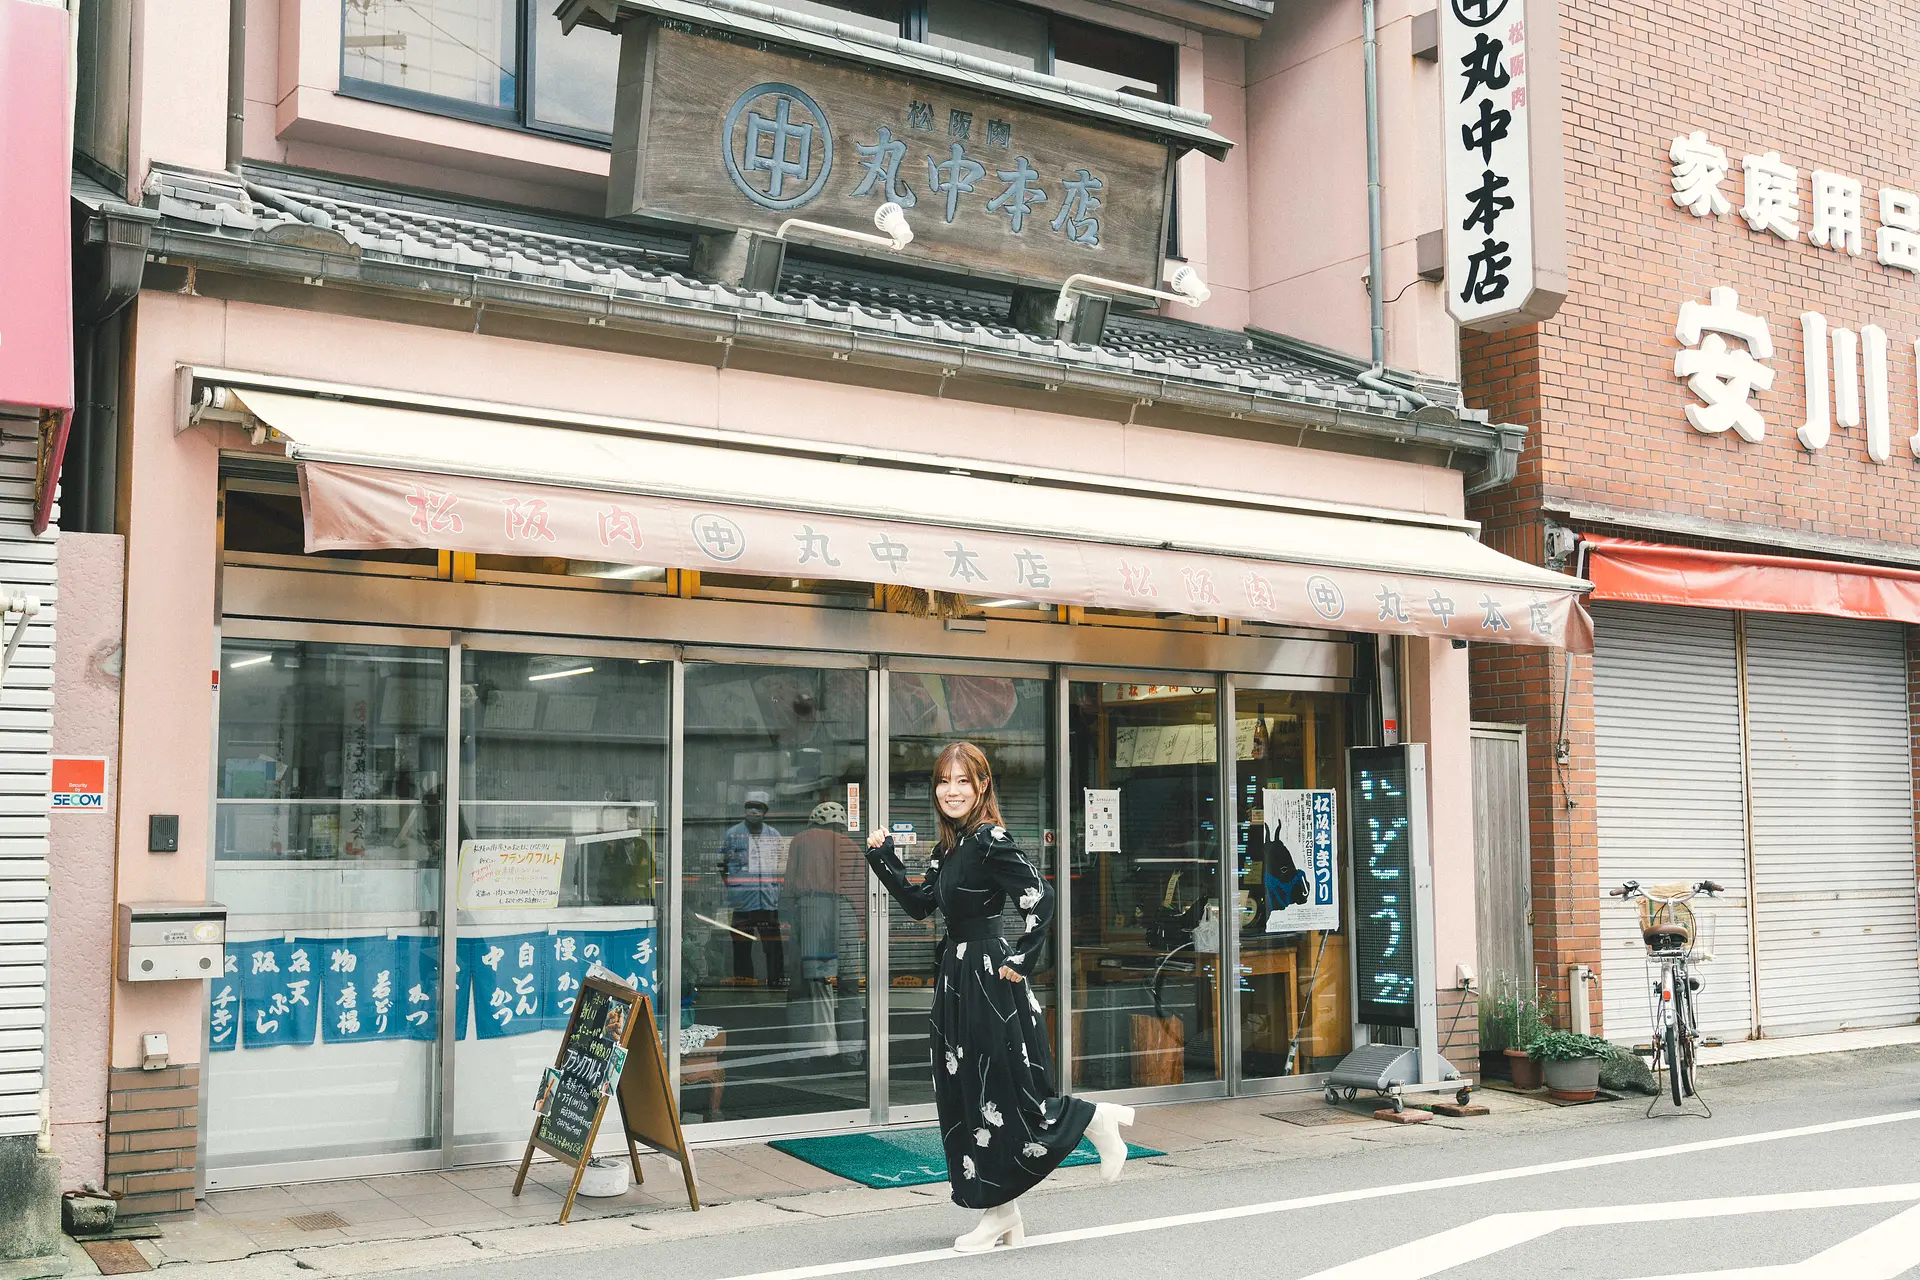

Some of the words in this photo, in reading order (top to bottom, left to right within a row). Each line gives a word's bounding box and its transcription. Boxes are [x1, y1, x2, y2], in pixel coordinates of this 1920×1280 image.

[1508, 20, 1526, 111] 松阪肉
[906, 99, 1012, 149] 松阪肉
[1460, 32, 1514, 305] 丸中本店
[850, 126, 1103, 247] 丸中本店
[1669, 130, 1920, 275] 家庭用品
[1674, 286, 1920, 463] 安川
[405, 484, 646, 551] 松阪肉
[793, 523, 1052, 590] 丸中本店
[1116, 558, 1277, 613] 松阪肉
[1377, 581, 1554, 636] 丸中本店
[53, 793, 101, 806] SECOM
[1314, 795, 1331, 902] 松阪牛まつり
[500, 852, 561, 866] フランクフルト
[211, 984, 236, 1043] チキン
[563, 1048, 602, 1084] フランクフルト
